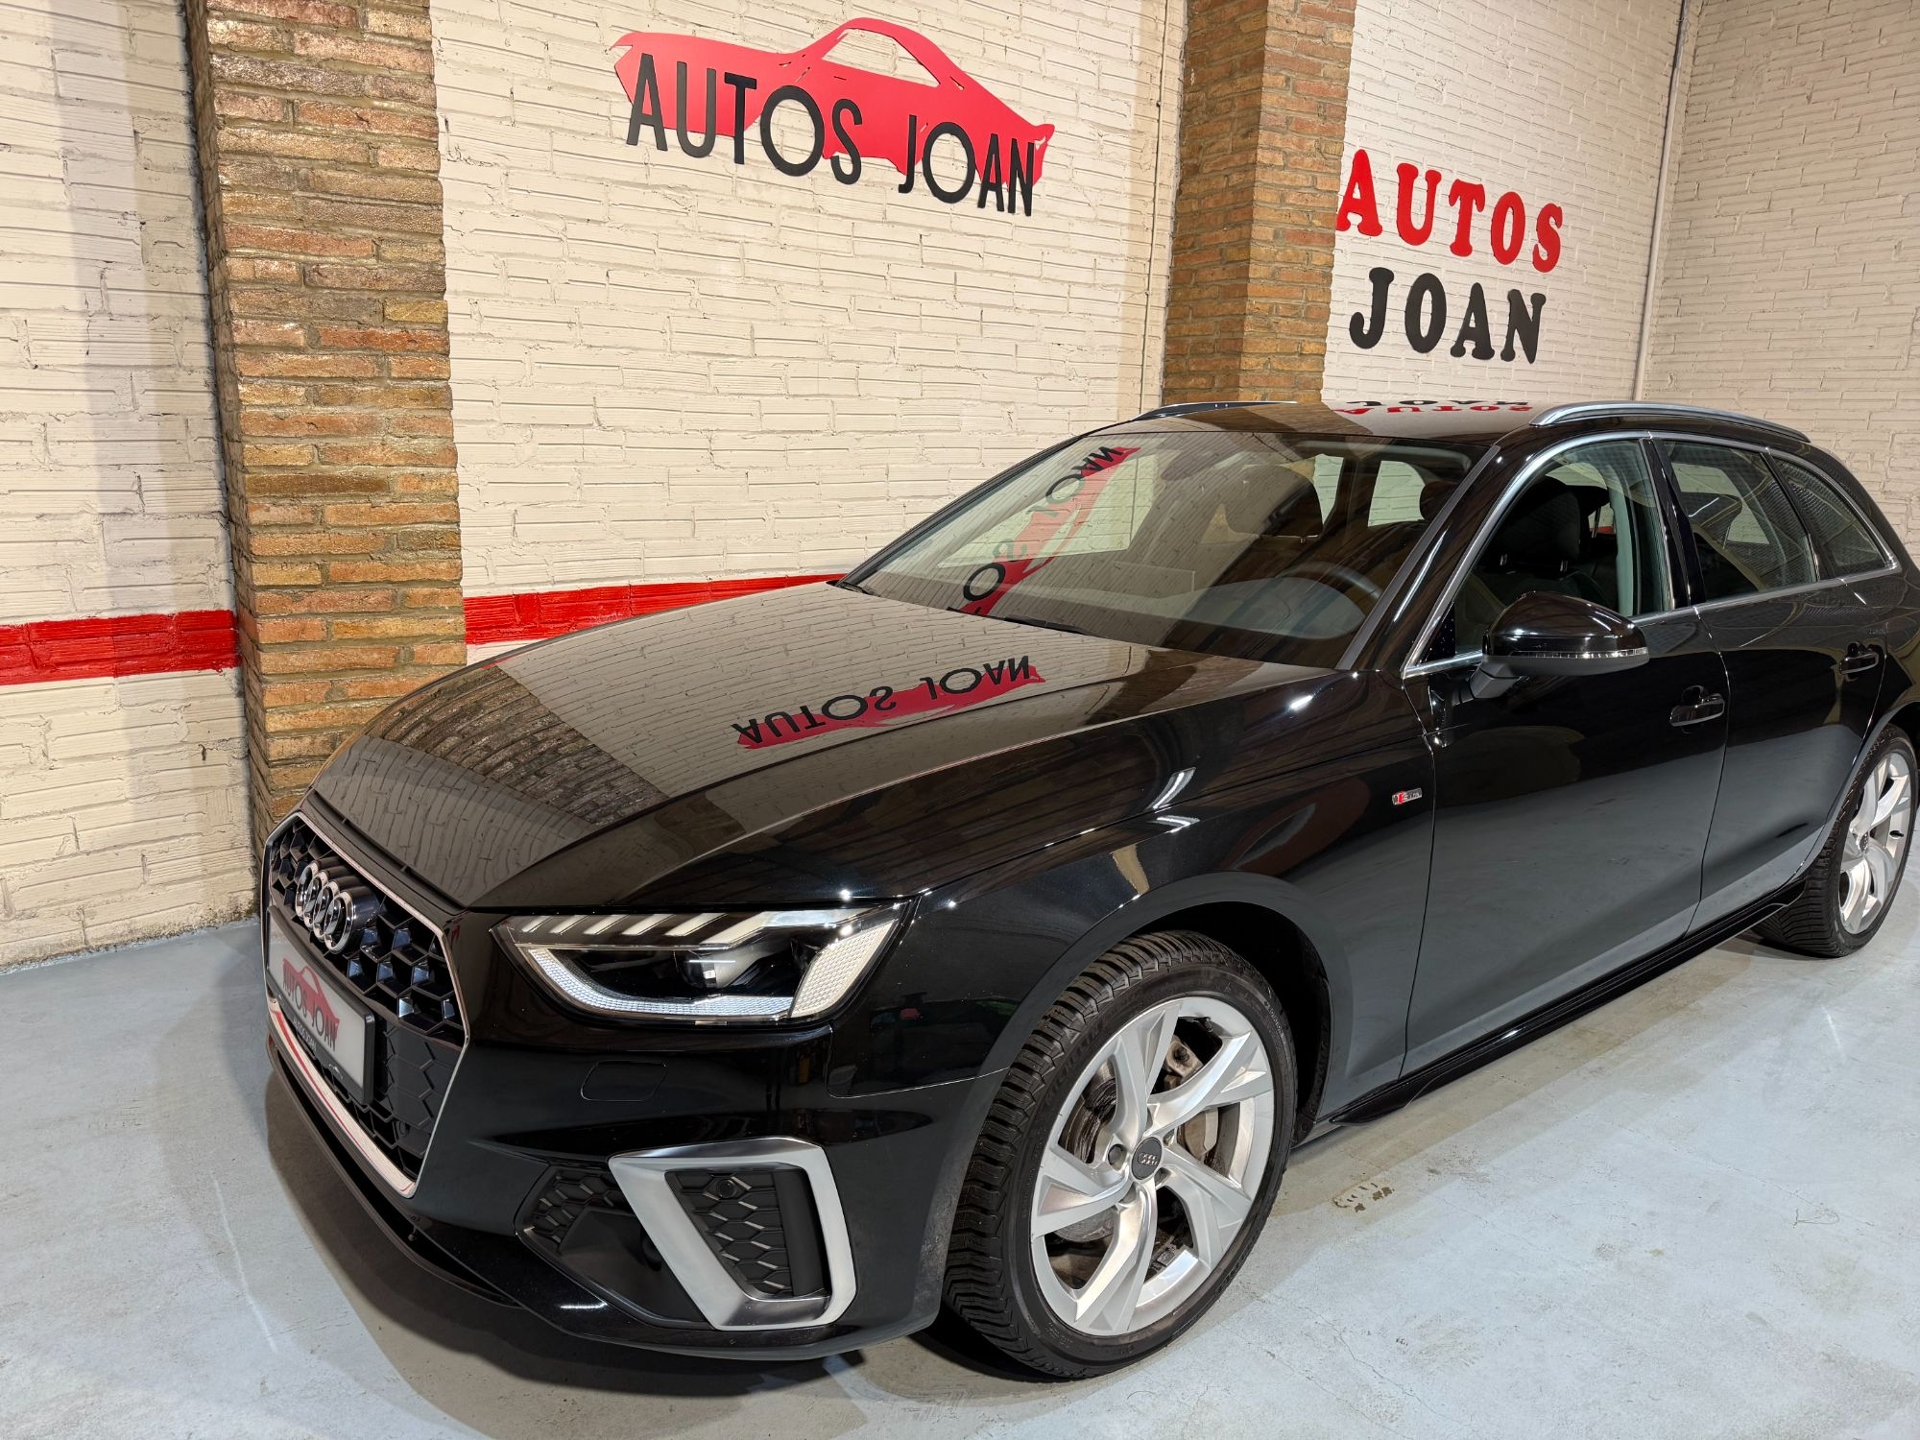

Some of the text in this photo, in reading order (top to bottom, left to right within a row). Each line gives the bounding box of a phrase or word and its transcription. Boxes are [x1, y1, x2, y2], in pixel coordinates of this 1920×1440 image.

[627, 52, 1034, 216] AUTOS JOAN
[1335, 149, 1563, 273] AUTOS
[1349, 267, 1547, 364] JOAN
[283, 965, 308, 1018] AUTOS
[311, 1000, 336, 1052] JOAN
